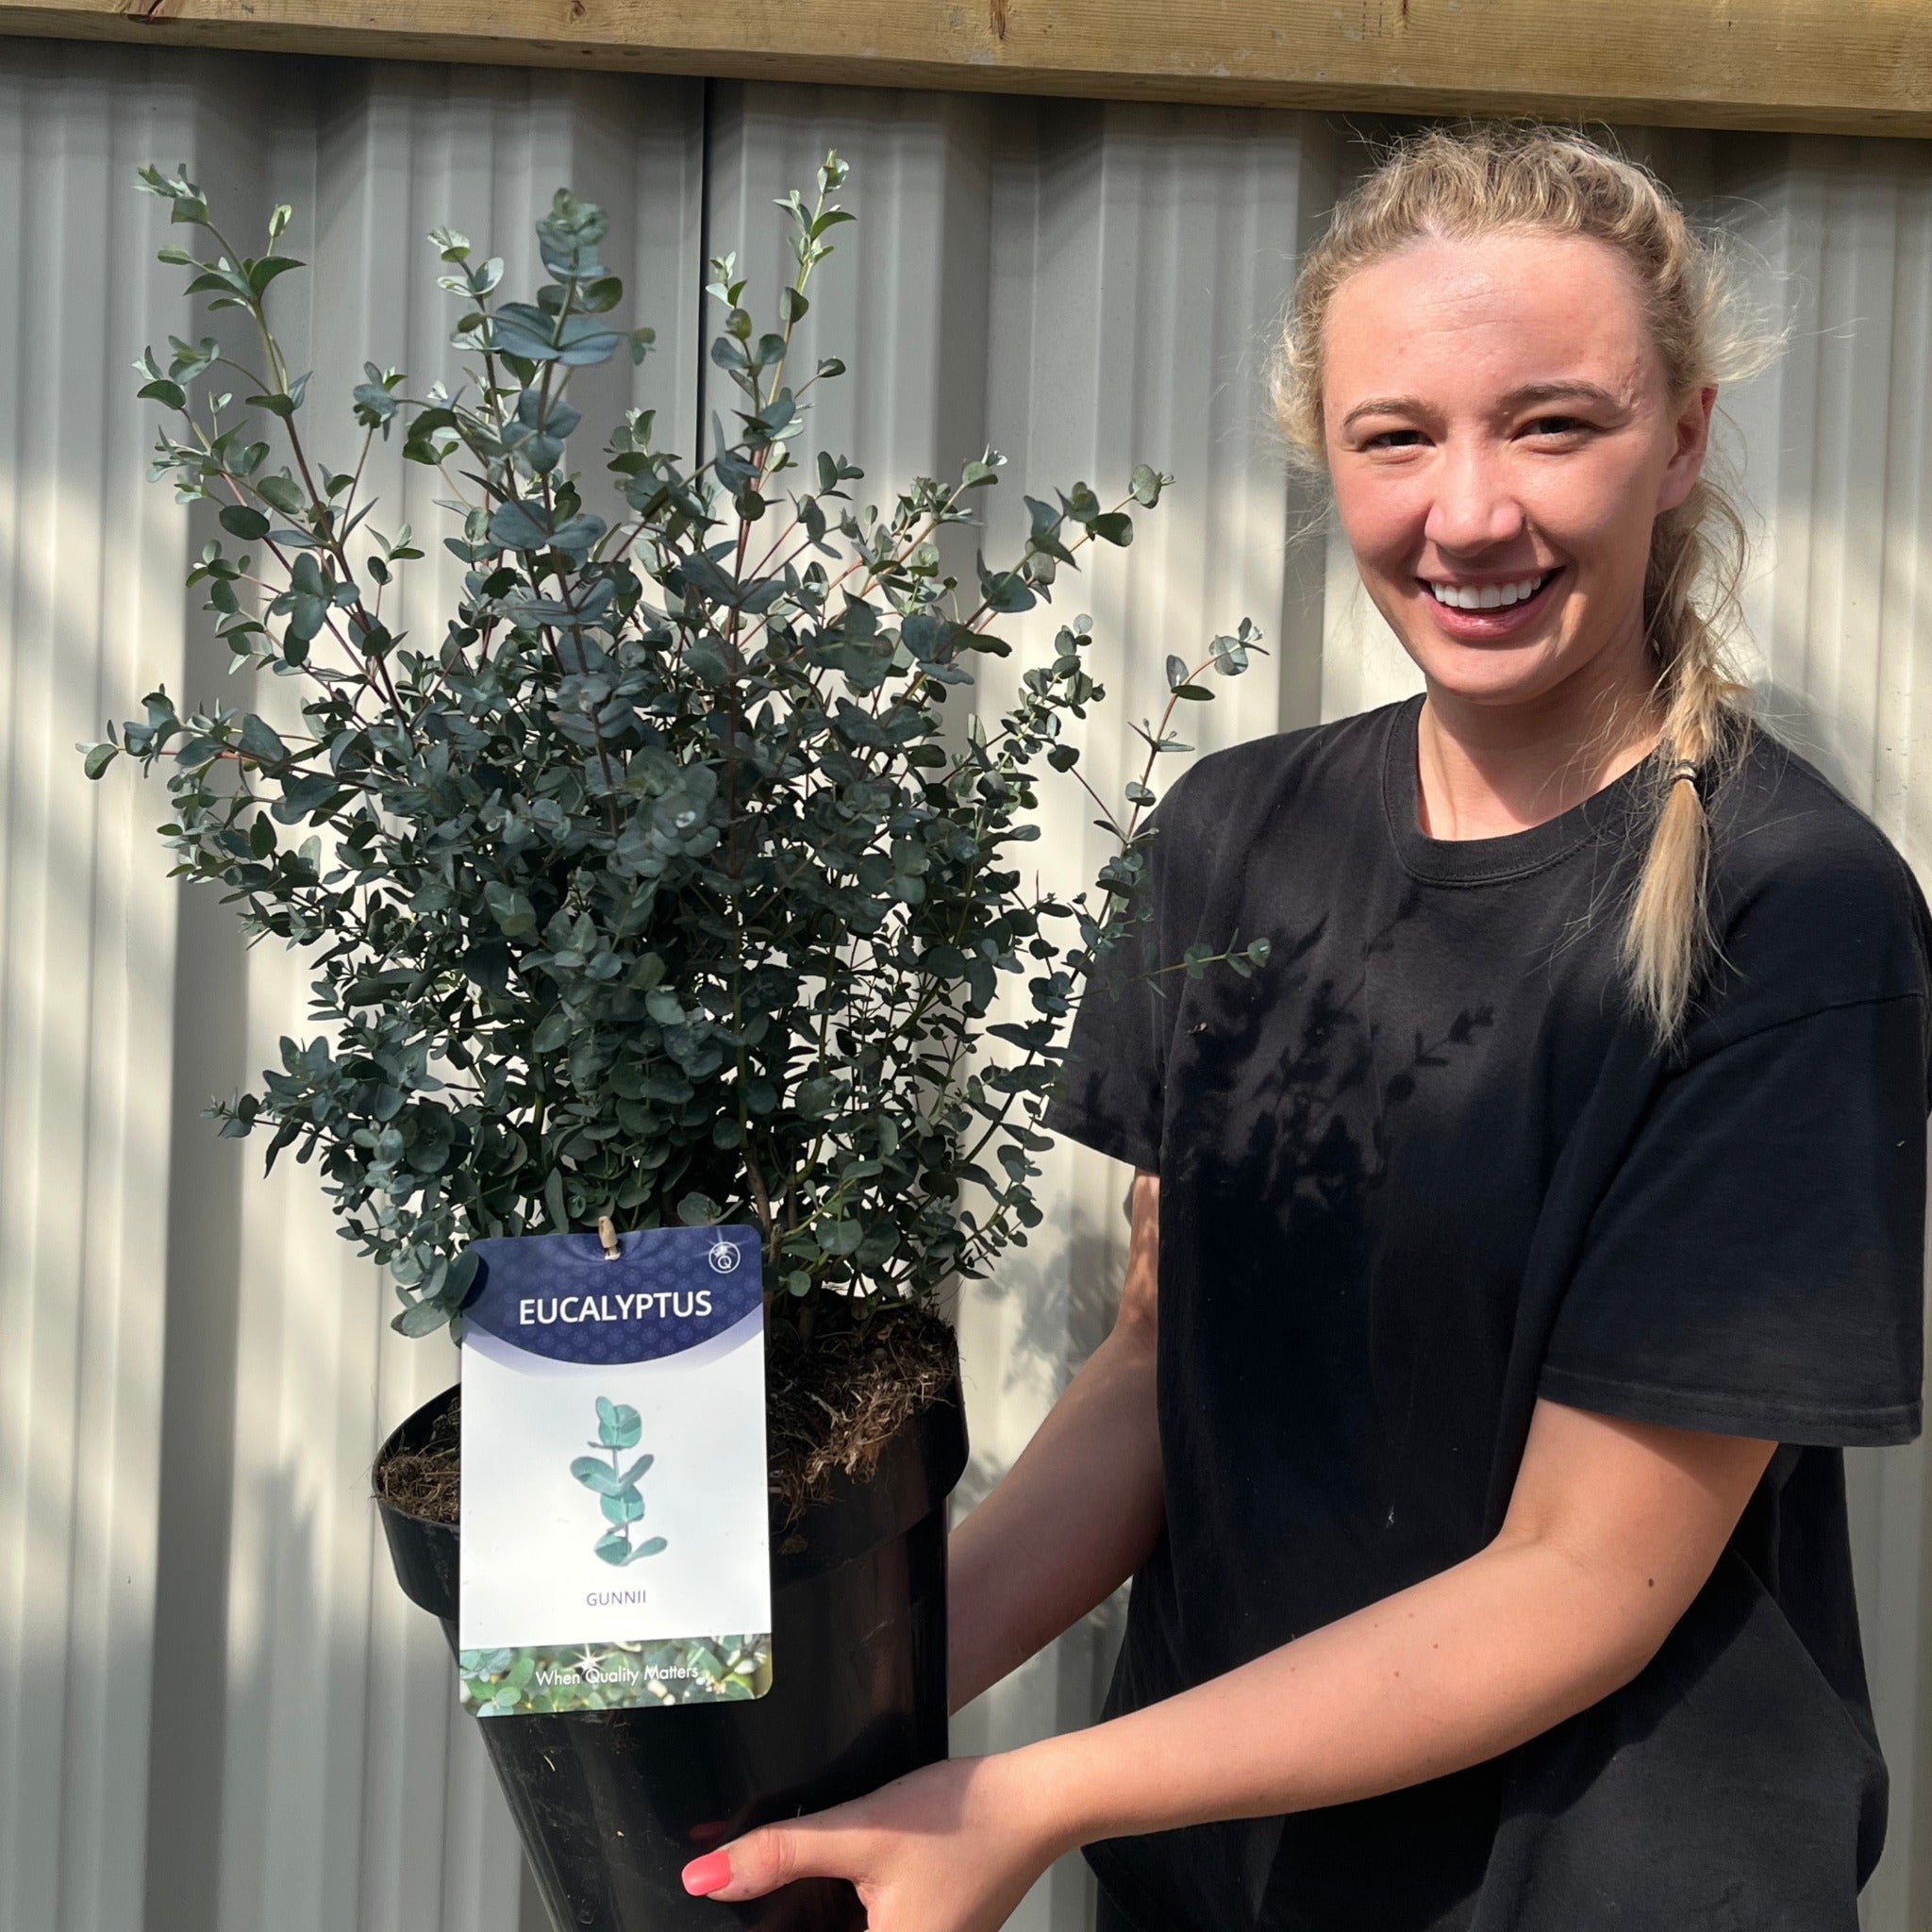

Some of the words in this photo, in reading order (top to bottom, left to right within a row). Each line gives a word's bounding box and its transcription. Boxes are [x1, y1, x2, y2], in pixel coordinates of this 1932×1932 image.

[519, 1290, 713, 1326] EUCALYPTUS
[586, 1590, 647, 1607] GUNNII
[535, 1669, 581, 1687] When
[585, 1667, 640, 1687] Quality
[643, 1664, 700, 1682] Matters
